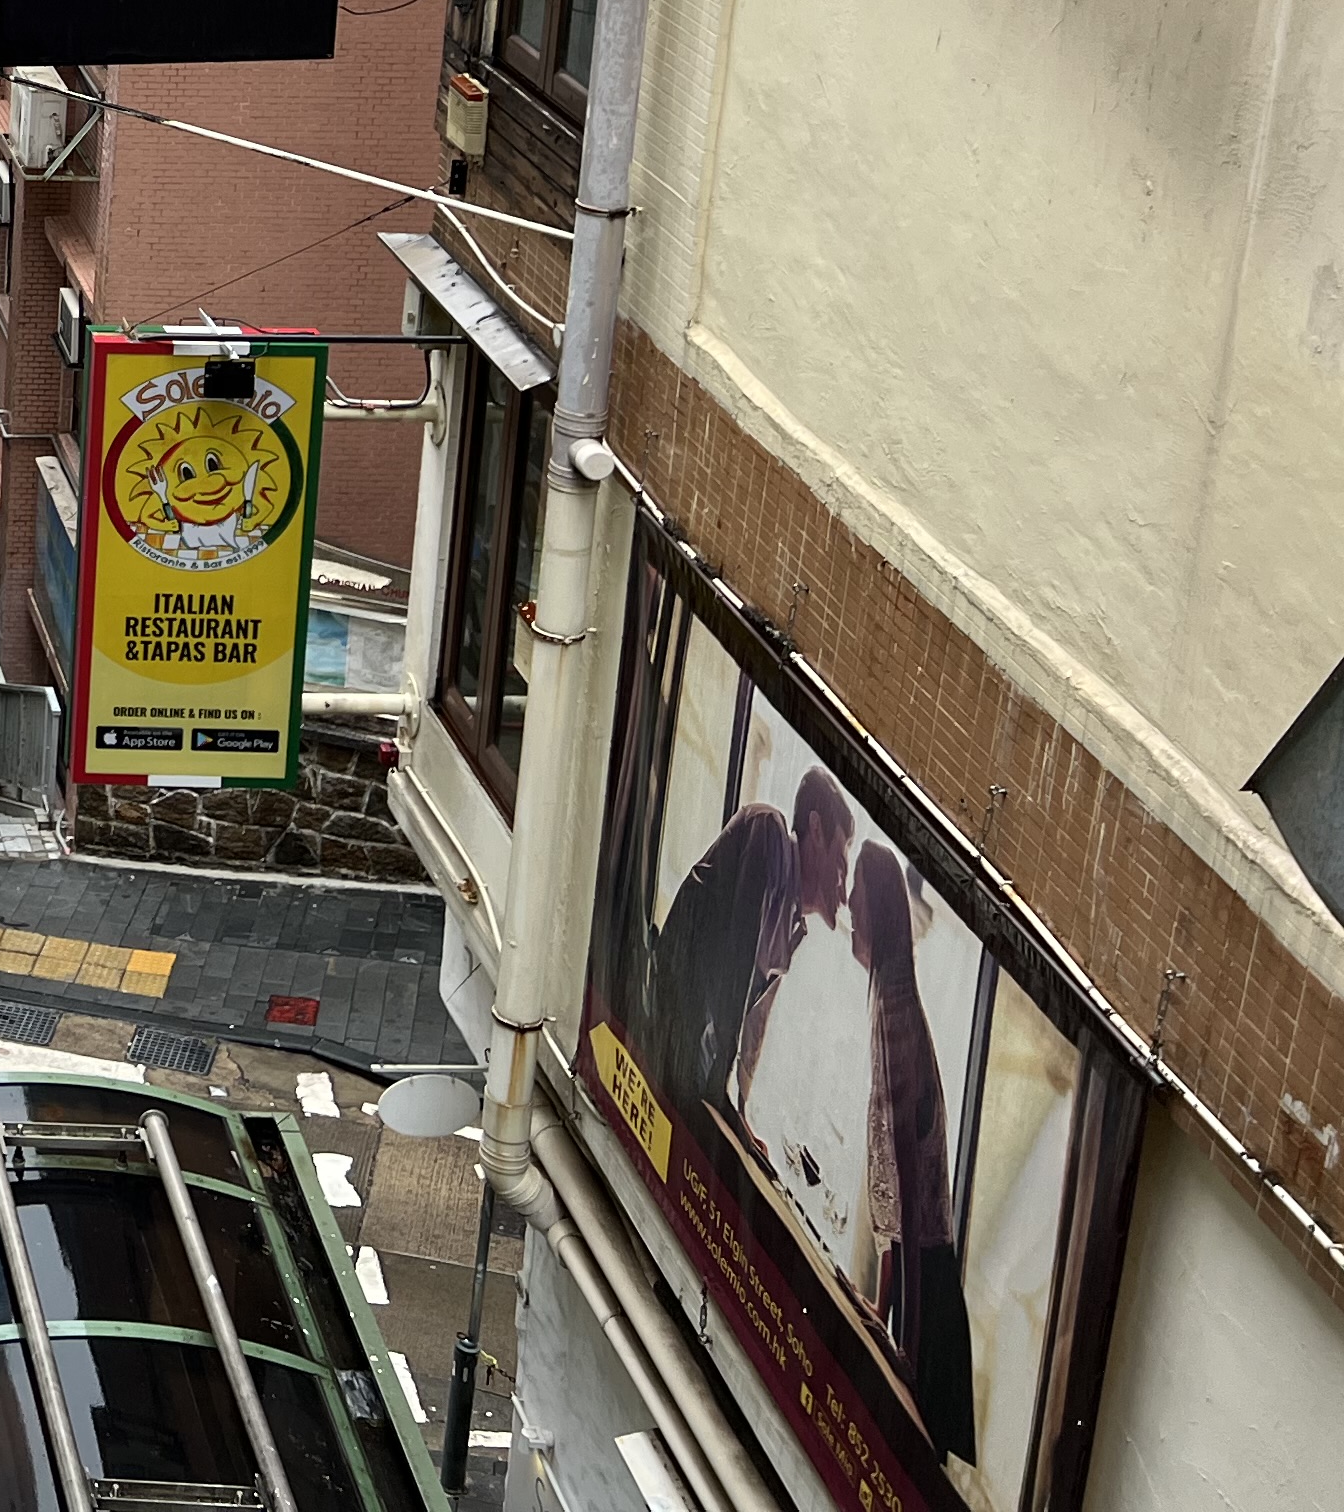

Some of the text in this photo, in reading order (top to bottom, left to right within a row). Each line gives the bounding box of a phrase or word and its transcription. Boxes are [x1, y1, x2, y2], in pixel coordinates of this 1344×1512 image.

[132, 540, 186, 568] Ristorante
[203, 560, 222, 569] Bar
[154, 593, 234, 615] ITALIAN
[125, 616, 262, 640] RESTAURANT
[214, 642, 257, 663] BAR
[113, 707, 147, 717] ORDER
[150, 707, 185, 718] ONLINE
[188, 708, 195, 718] &
[199, 709, 221, 719] FIND
[225, 709, 238, 719] US
[241, 710, 255, 720] ON
[122, 736, 175, 747] App Store
[217, 738, 274, 750] Google Play
[615, 1048, 654, 1128] WE'RE
[612, 1073, 653, 1152] HERE!
[680, 1190, 786, 1372] www.solemio.com.hk
[709, 1200, 721, 1229] 51
[722, 1222, 748, 1270] Elgin
[786, 1323, 813, 1377] Soho
[826, 1383, 846, 1429] Tel:
[848, 1422, 869, 1468] 852
